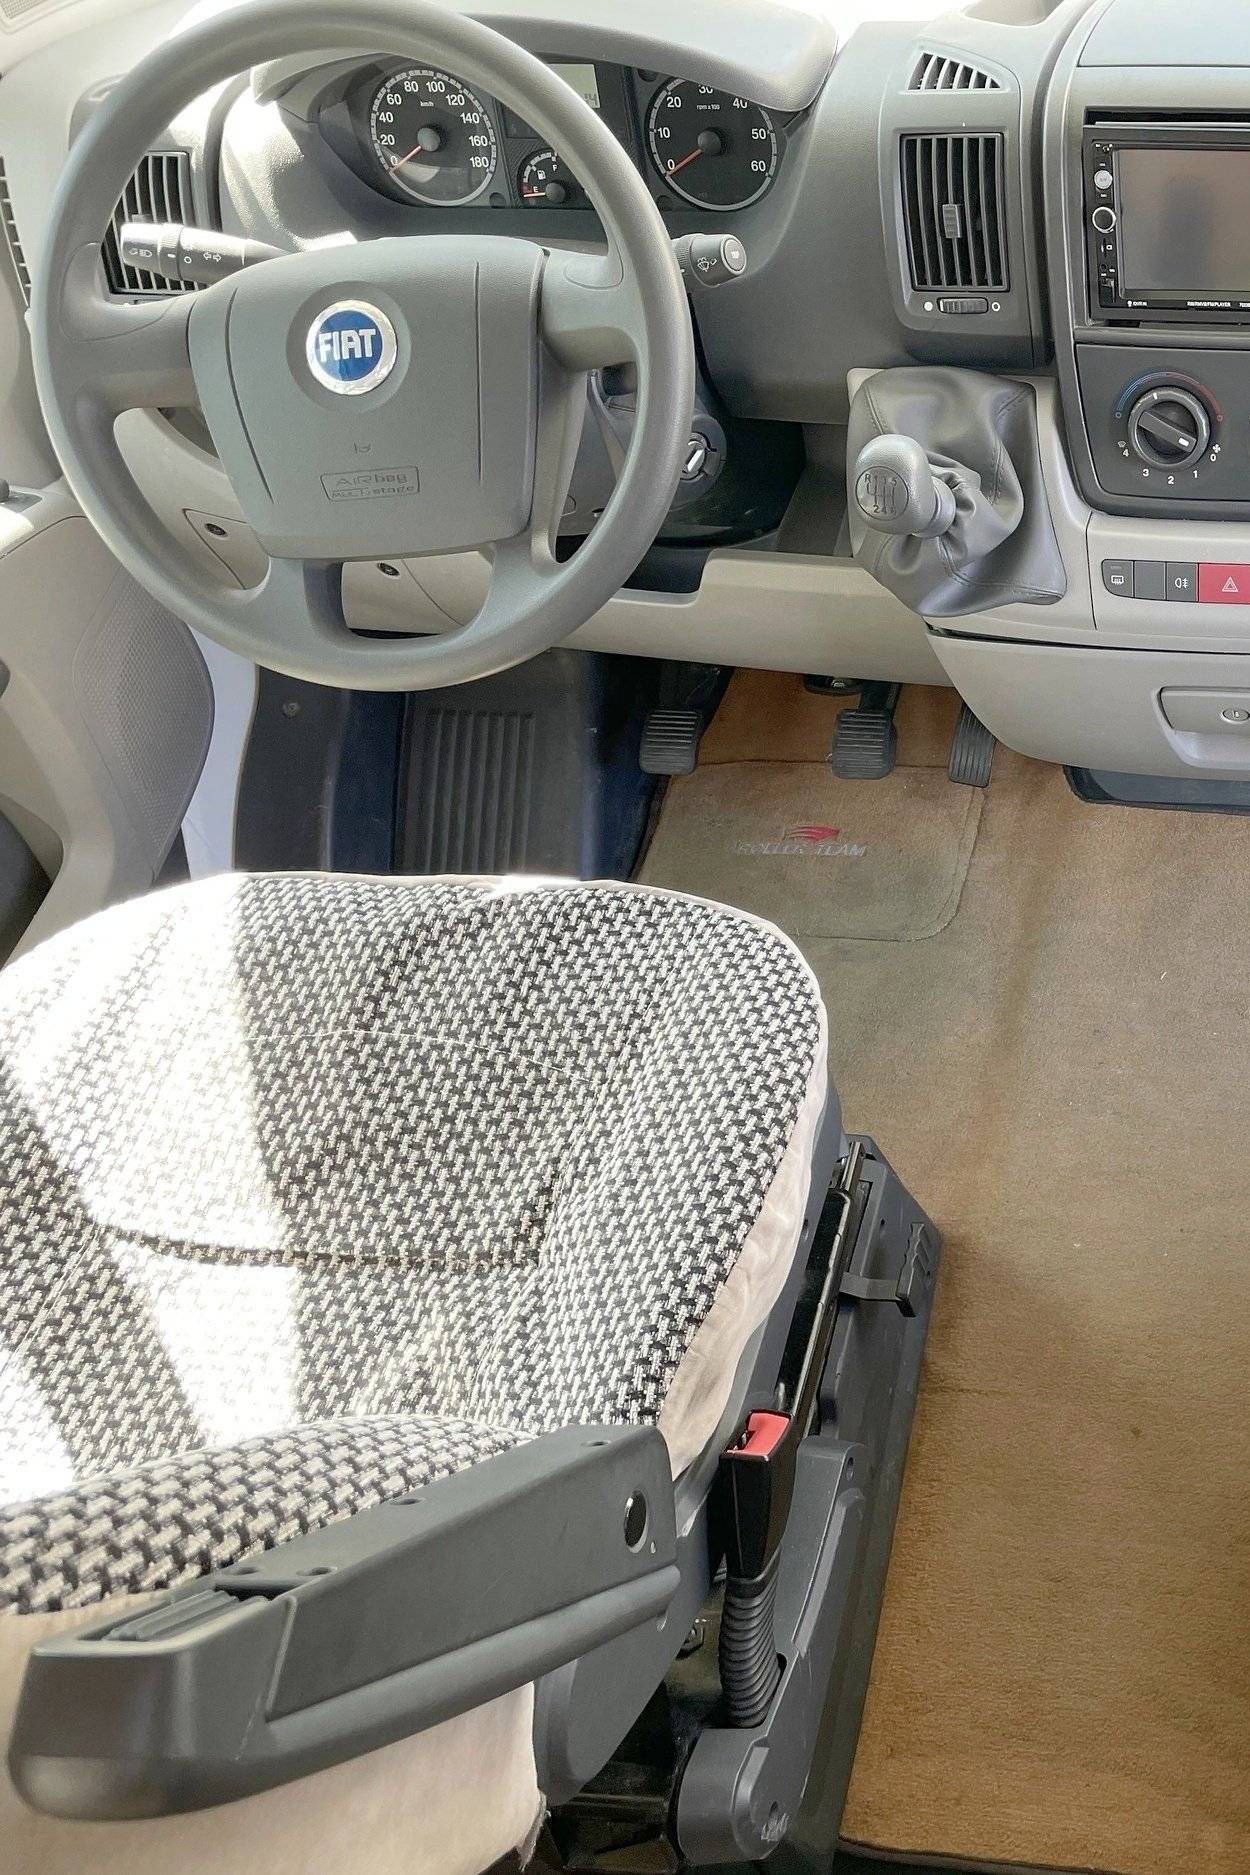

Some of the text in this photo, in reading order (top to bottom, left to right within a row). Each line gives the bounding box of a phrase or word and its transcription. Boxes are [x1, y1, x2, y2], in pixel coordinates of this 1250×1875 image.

[404, 81, 418, 92] 80
[426, 81, 445, 92] 100
[387, 94, 402, 105] 60
[446, 94, 465, 106] 120
[667, 96, 681, 108] 20
[732, 98, 748, 109] 40
[379, 112, 393, 123] 40
[460, 112, 479, 124] 140
[657, 127, 670, 139] 10
[751, 128, 766, 140] 50
[380, 134, 395, 145] 20
[469, 135, 488, 147] 160
[390, 156, 398, 166] 0
[470, 156, 489, 168] 180
[667, 159, 675, 170] 0
[751, 160, 766, 172] 60
[318, 328, 377, 363] FIAT
[1122, 449, 1129, 457] 4
[1210, 454, 1217, 462] 0
[1142, 469, 1149, 477] 3
[1193, 470, 1198, 478] 1
[1168, 476, 1175, 485] 2
